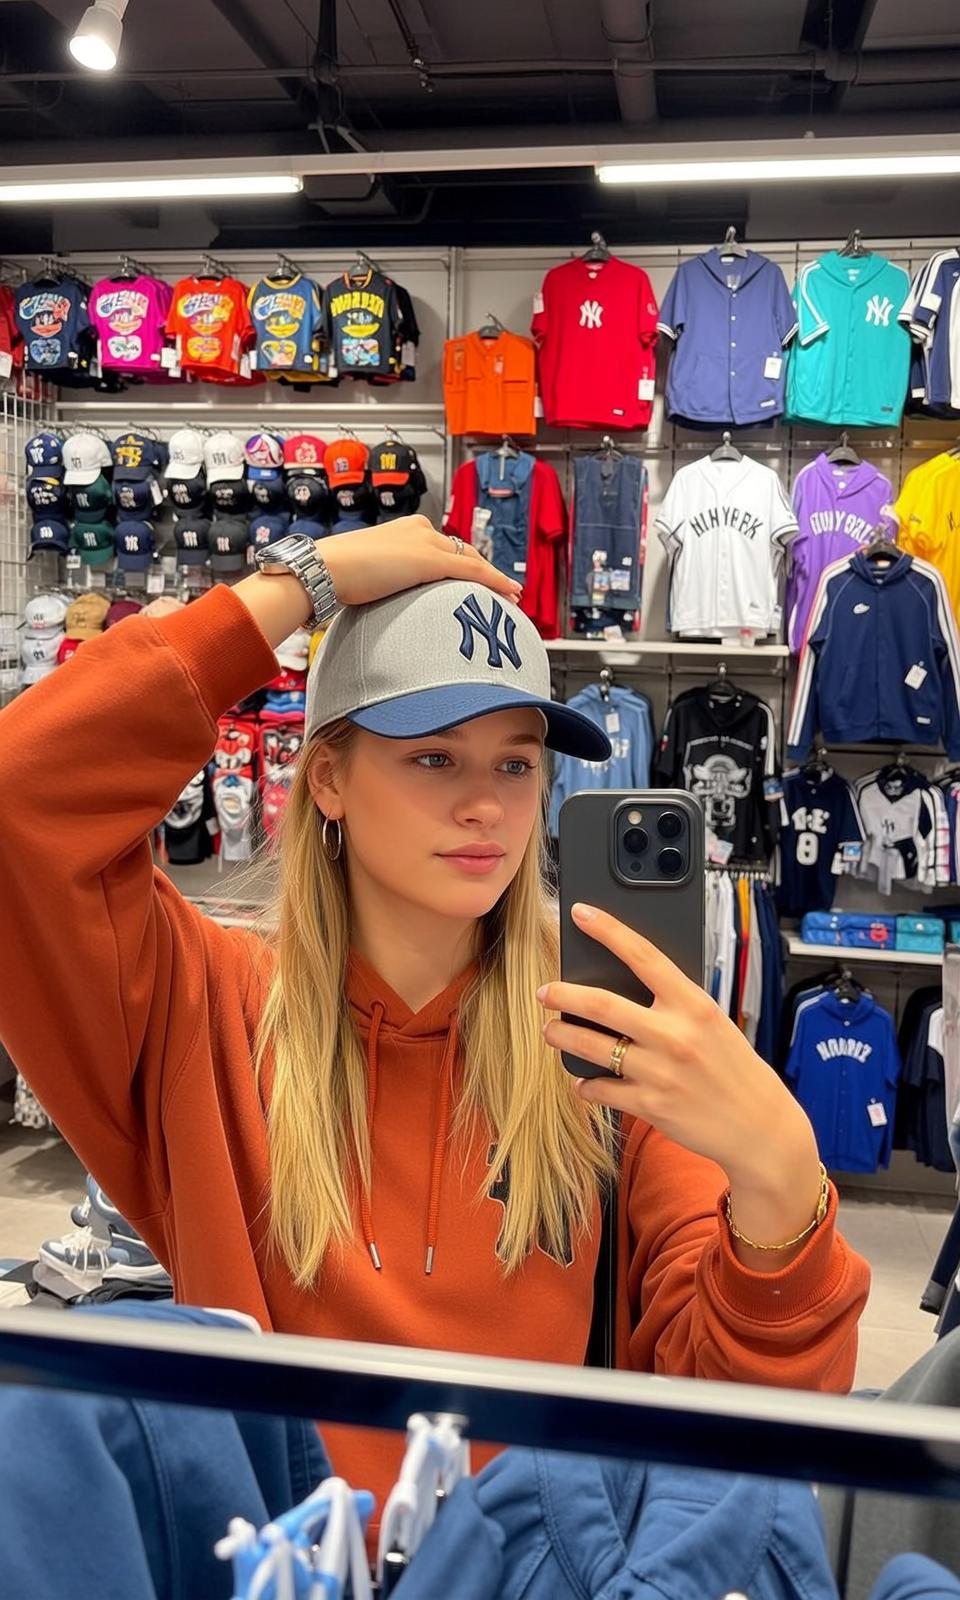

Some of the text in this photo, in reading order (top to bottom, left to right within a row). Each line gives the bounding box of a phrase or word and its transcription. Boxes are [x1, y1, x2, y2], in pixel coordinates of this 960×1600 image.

[579, 299, 604, 329] NY
[865, 294, 895, 327] NY
[452, 592, 523, 672] NY
